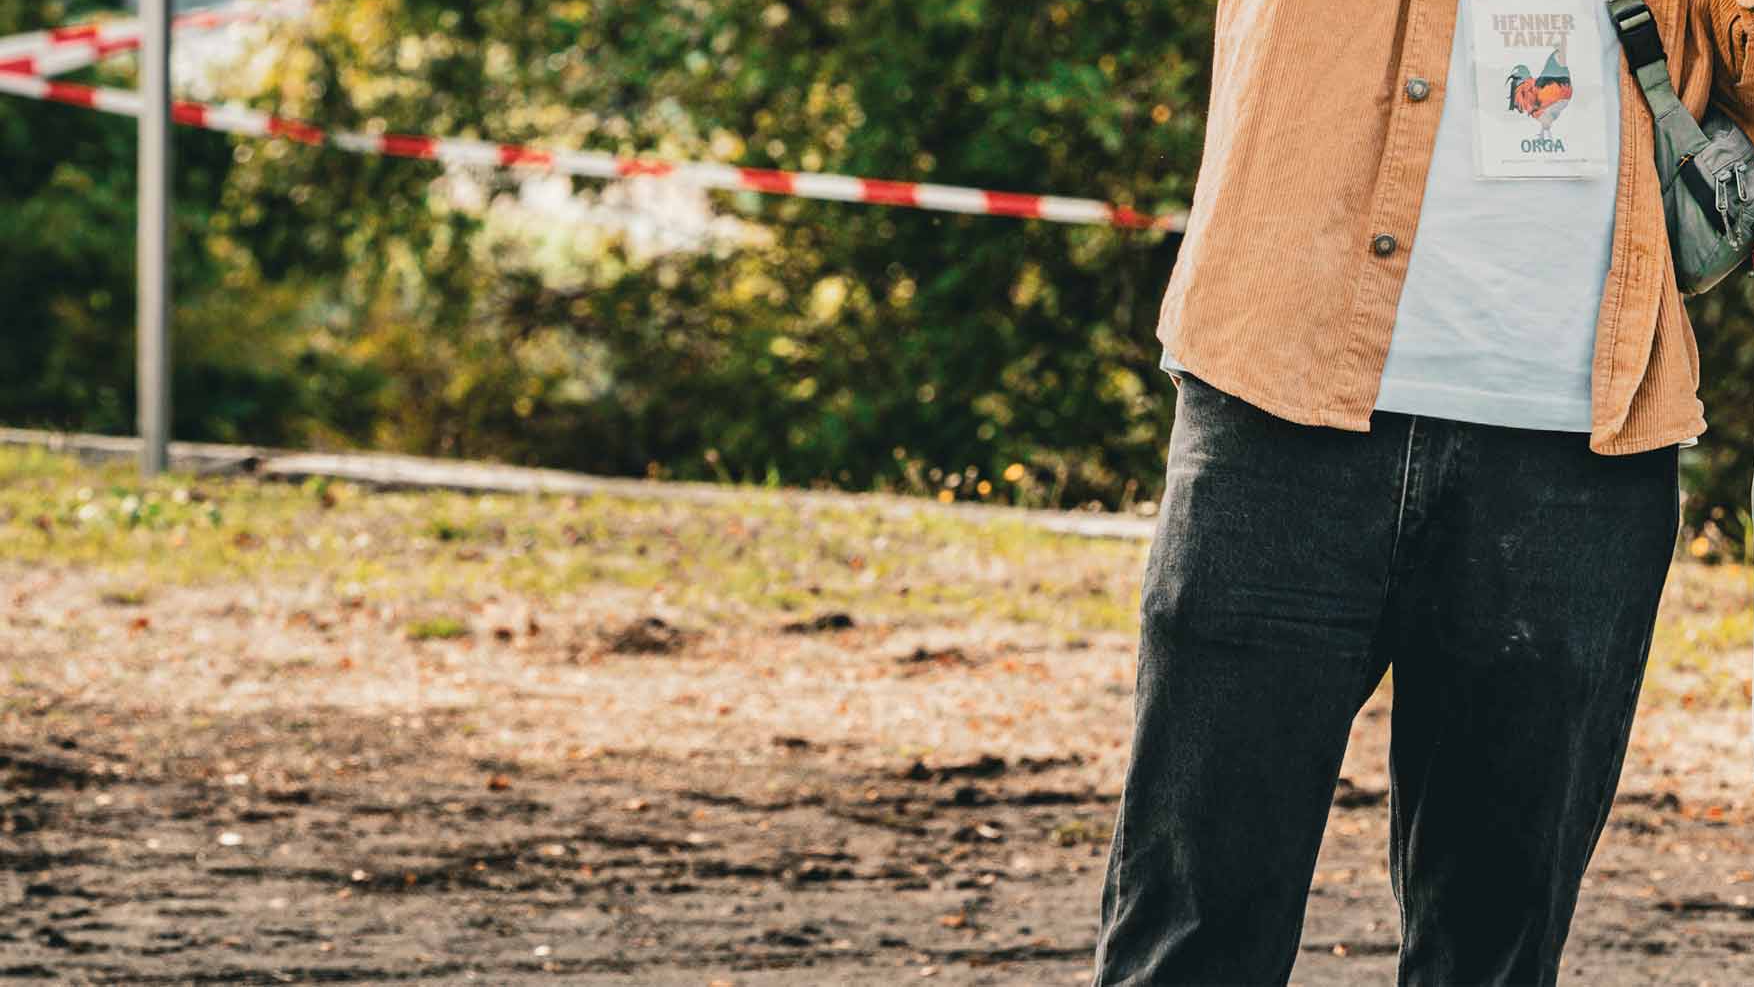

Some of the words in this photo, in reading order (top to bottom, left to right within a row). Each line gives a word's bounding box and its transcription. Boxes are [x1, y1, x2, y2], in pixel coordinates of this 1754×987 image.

[1492, 14, 1576, 30] HENNER
[1499, 30, 1568, 48] TANZT
[1520, 139, 1566, 153] ORGA
